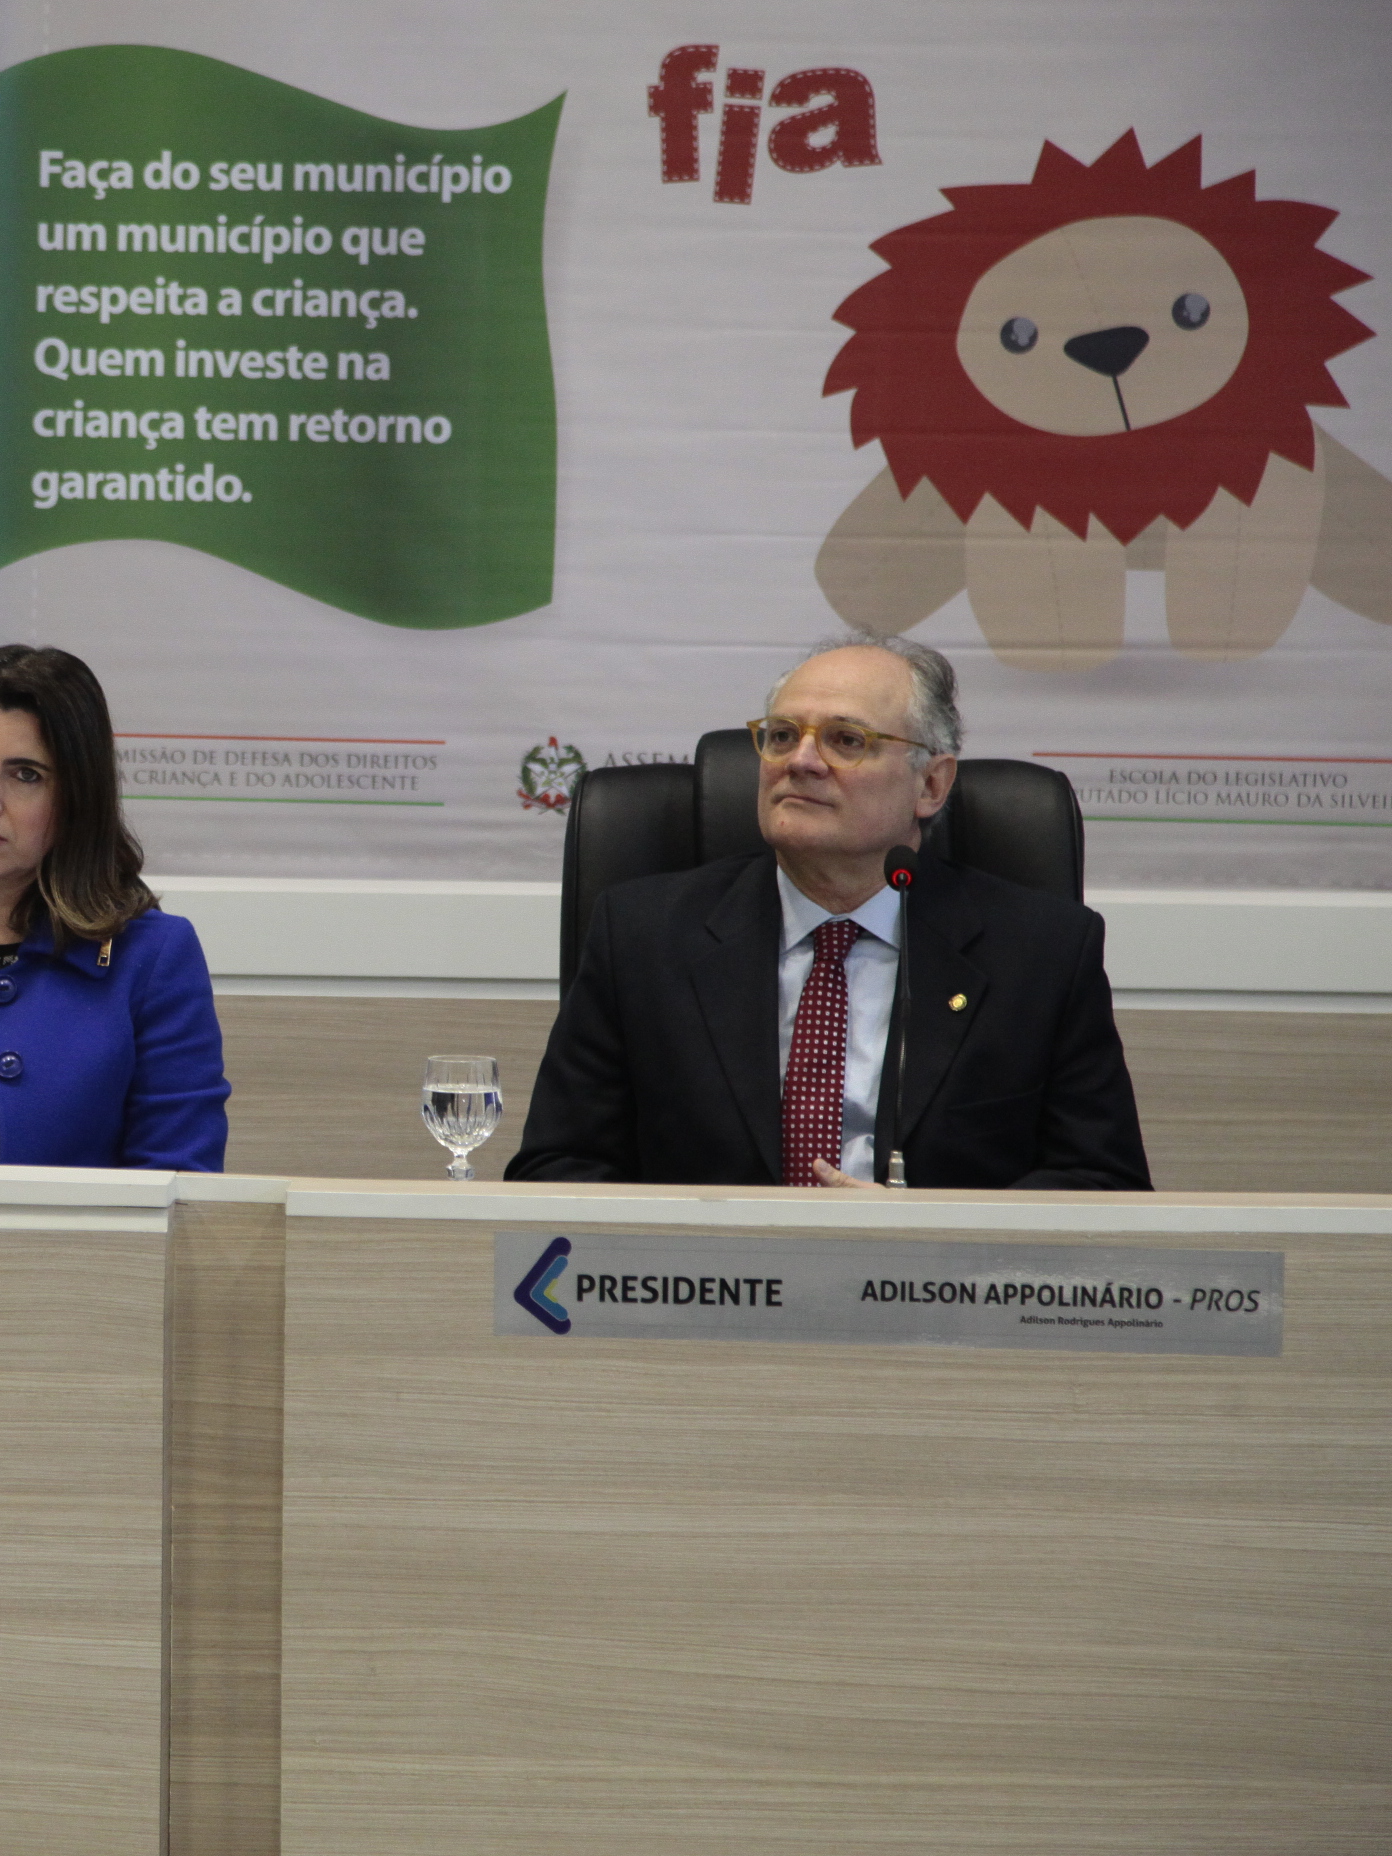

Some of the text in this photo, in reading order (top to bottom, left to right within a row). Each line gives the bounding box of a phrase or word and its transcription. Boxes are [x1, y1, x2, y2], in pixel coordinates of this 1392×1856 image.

[39, 149, 513, 204] Faça do seu município
[37, 214, 426, 266] um município que
[36, 275, 418, 329] respeita a criança.
[34, 337, 391, 381] Quem investe na
[32, 398, 453, 451] criança tem retorno
[31, 462, 253, 509] garantido.
[115, 747, 438, 771] MISSÃO DE DEFESA DOS DIREITOS
[132, 769, 223, 788] CRIANÇA
[229, 771, 239, 787] E
[246, 772, 276, 788] DO
[281, 773, 420, 791] ADOLESCENTE
[1109, 768, 1348, 789] ESCOLA DO LEGISLATIVO
[1079, 788, 1149, 804] UTADO
[1215, 791, 1290, 808] MAURO
[1296, 793, 1328, 809] DA
[1329, 794, 1392, 810] SILVEI
[576, 1273, 783, 1308] PRESIDENTE
[860, 1279, 977, 1305] ADILSON
[983, 1281, 1164, 1311] APPOLINÁRIO
[1188, 1287, 1261, 1314] PROS
[1018, 1314, 1164, 1330] Adilson Rodrigues Appolinário
